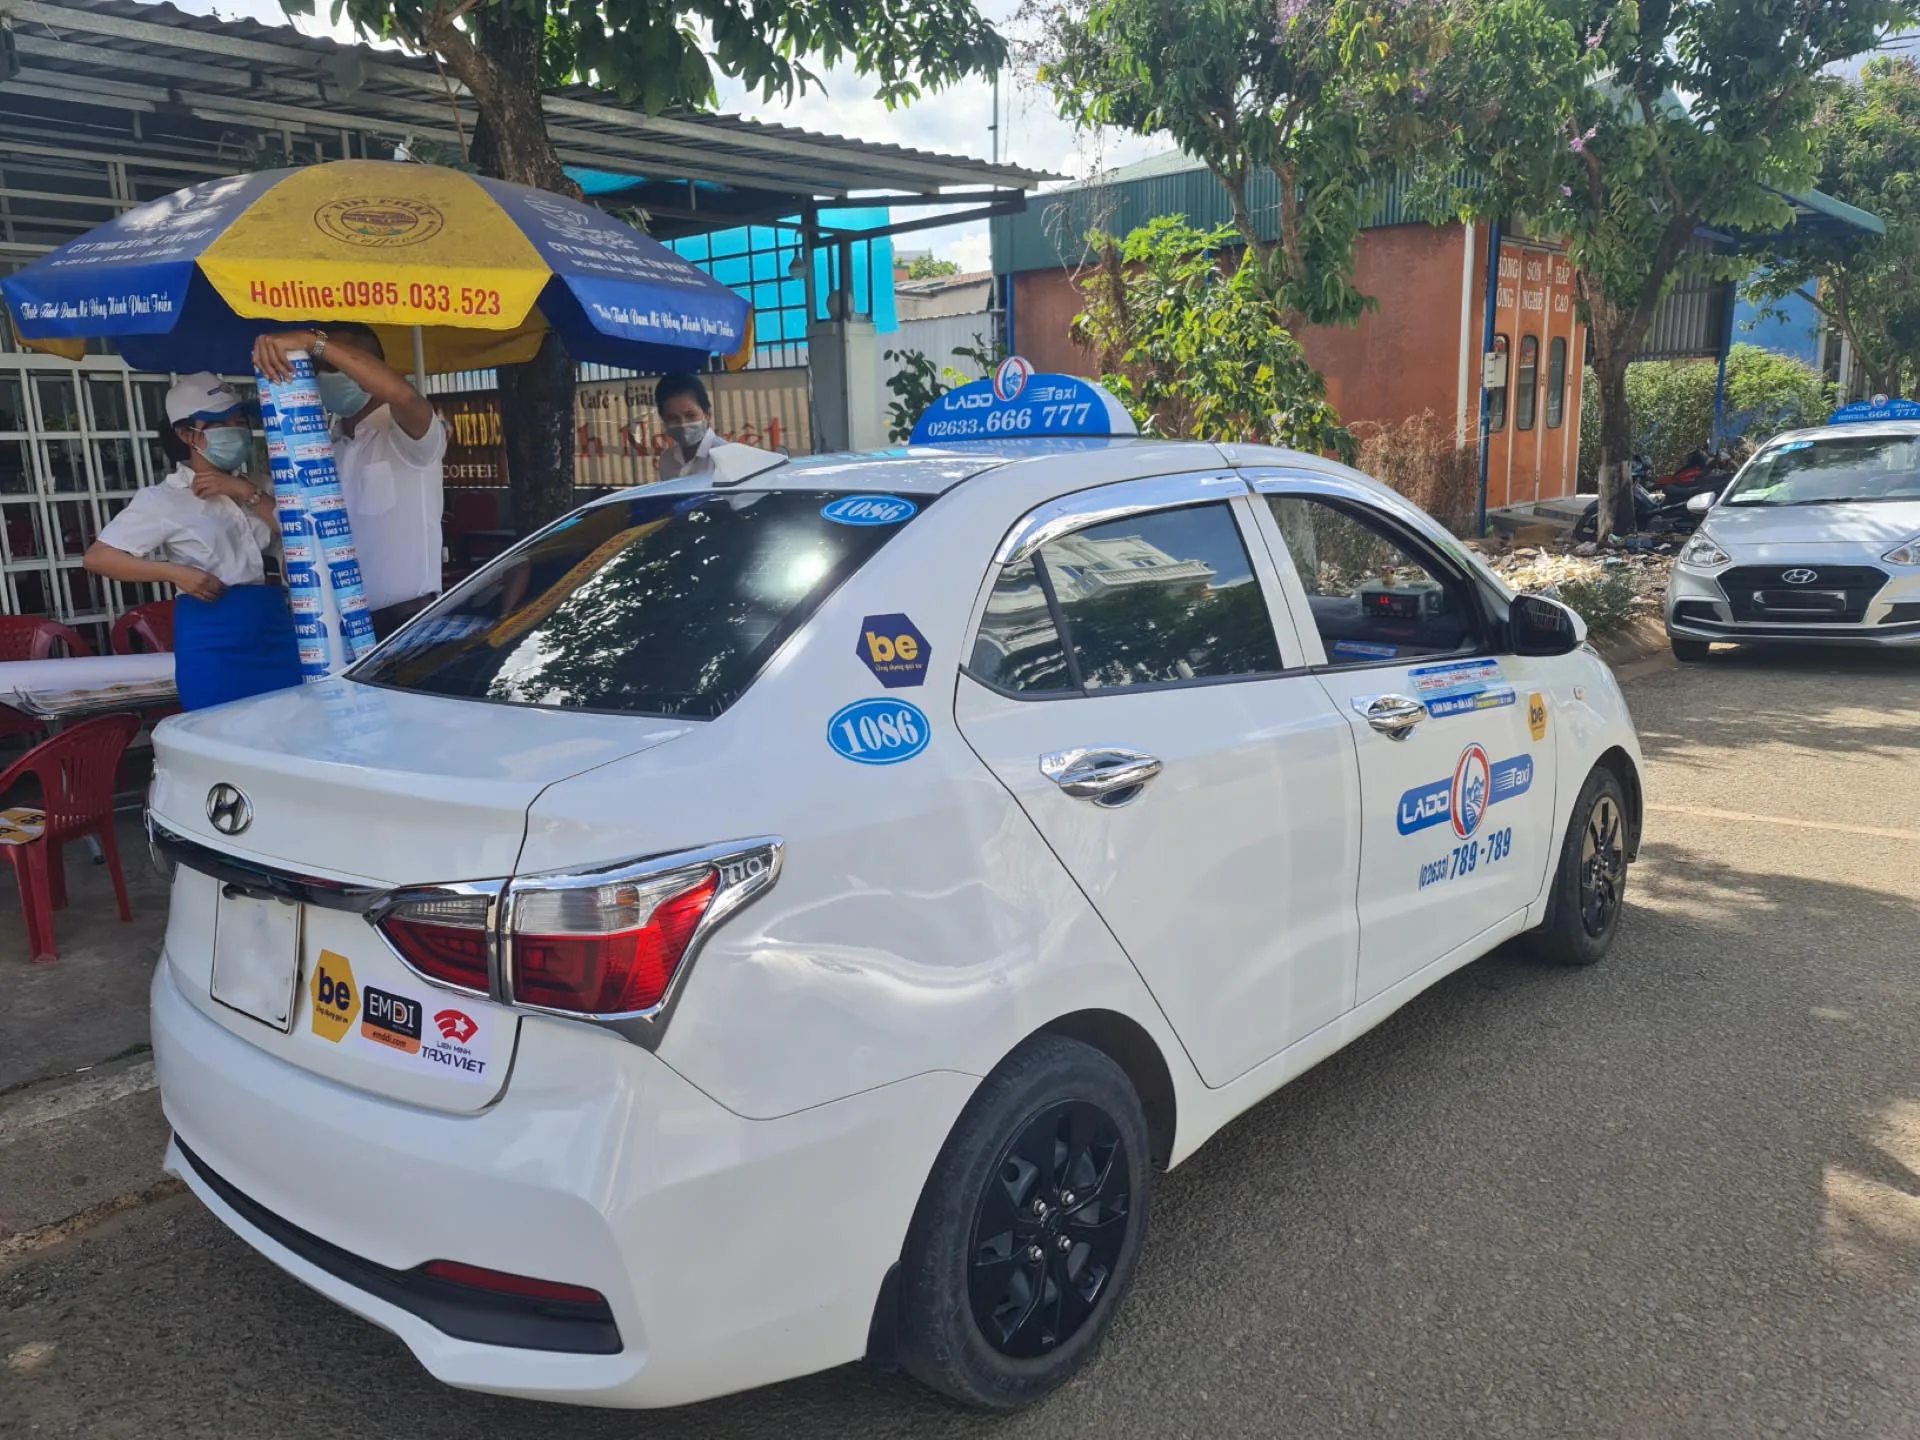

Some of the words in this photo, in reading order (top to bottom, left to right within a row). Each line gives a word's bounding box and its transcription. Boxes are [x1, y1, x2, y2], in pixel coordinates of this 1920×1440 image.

[1496, 282, 1514, 308] ÔNG
[1555, 294, 1569, 312] CAO
[944, 393, 993, 410] LADO
[1044, 384, 1077, 401] Taxi
[1896, 407, 1918, 417] 777
[928, 407, 1032, 437] 02633.666
[1042, 403, 1092, 428] 777
[441, 464, 498, 478] COFFEE
[831, 498, 904, 521] 1086
[865, 631, 918, 662] be
[1530, 704, 1544, 724] be
[838, 709, 920, 755] 1086
[1401, 789, 1450, 825] LADO
[1503, 762, 1531, 789] Taxi
[1419, 855, 1449, 891] (02633)
[318, 966, 351, 1011] be
